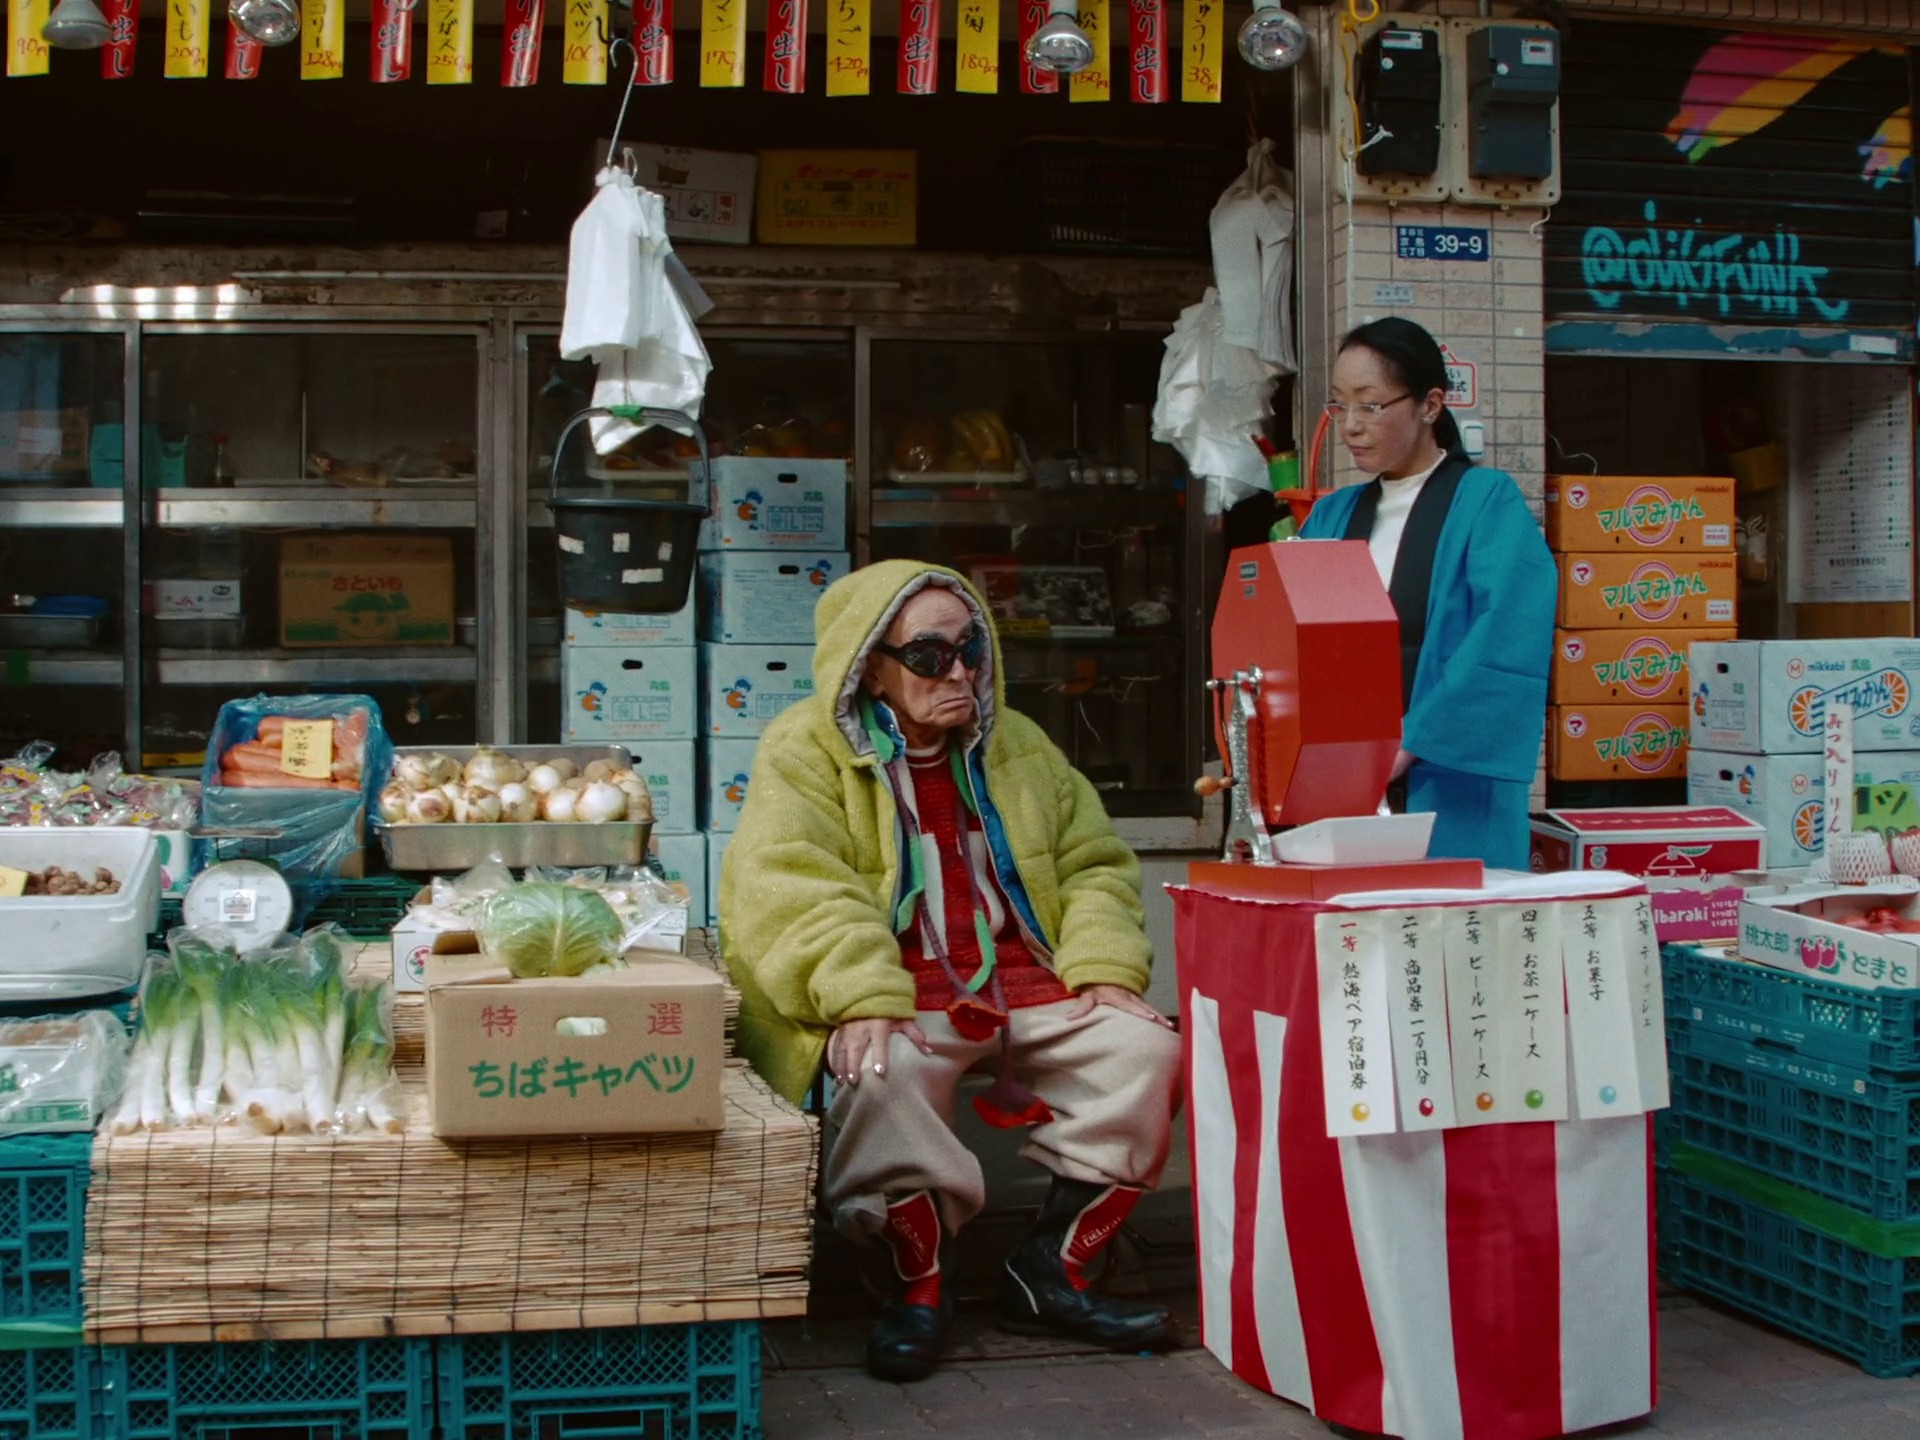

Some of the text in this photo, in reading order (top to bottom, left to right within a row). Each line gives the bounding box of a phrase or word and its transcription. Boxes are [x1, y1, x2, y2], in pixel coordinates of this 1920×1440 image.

[905, 0, 931, 91] り出し
[1434, 234, 1482, 254] 39-9
[1597, 497, 1705, 533] マルマみかん
[332, 575, 404, 592] さといも
[1602, 572, 1709, 609] マルマみかん
[1594, 652, 1689, 685] マルマみか
[1595, 727, 1690, 760] マルマみか
[1826, 713, 1847, 834] みつ入りりん
[1465, 911, 1481, 945] 三等
[1522, 909, 1538, 943] 四等
[1654, 906, 1708, 923] Ibaraki
[1340, 922, 1358, 952] 一等
[1582, 905, 1604, 1001] 五等 お菓子
[1745, 924, 1790, 953] 桃太郎
[1852, 951, 1908, 986] とまと
[1402, 916, 1431, 1086] 二等 商品券一万円分
[481, 1003, 683, 1038] 特 選
[468, 1052, 696, 1099] ちばキャベツ
